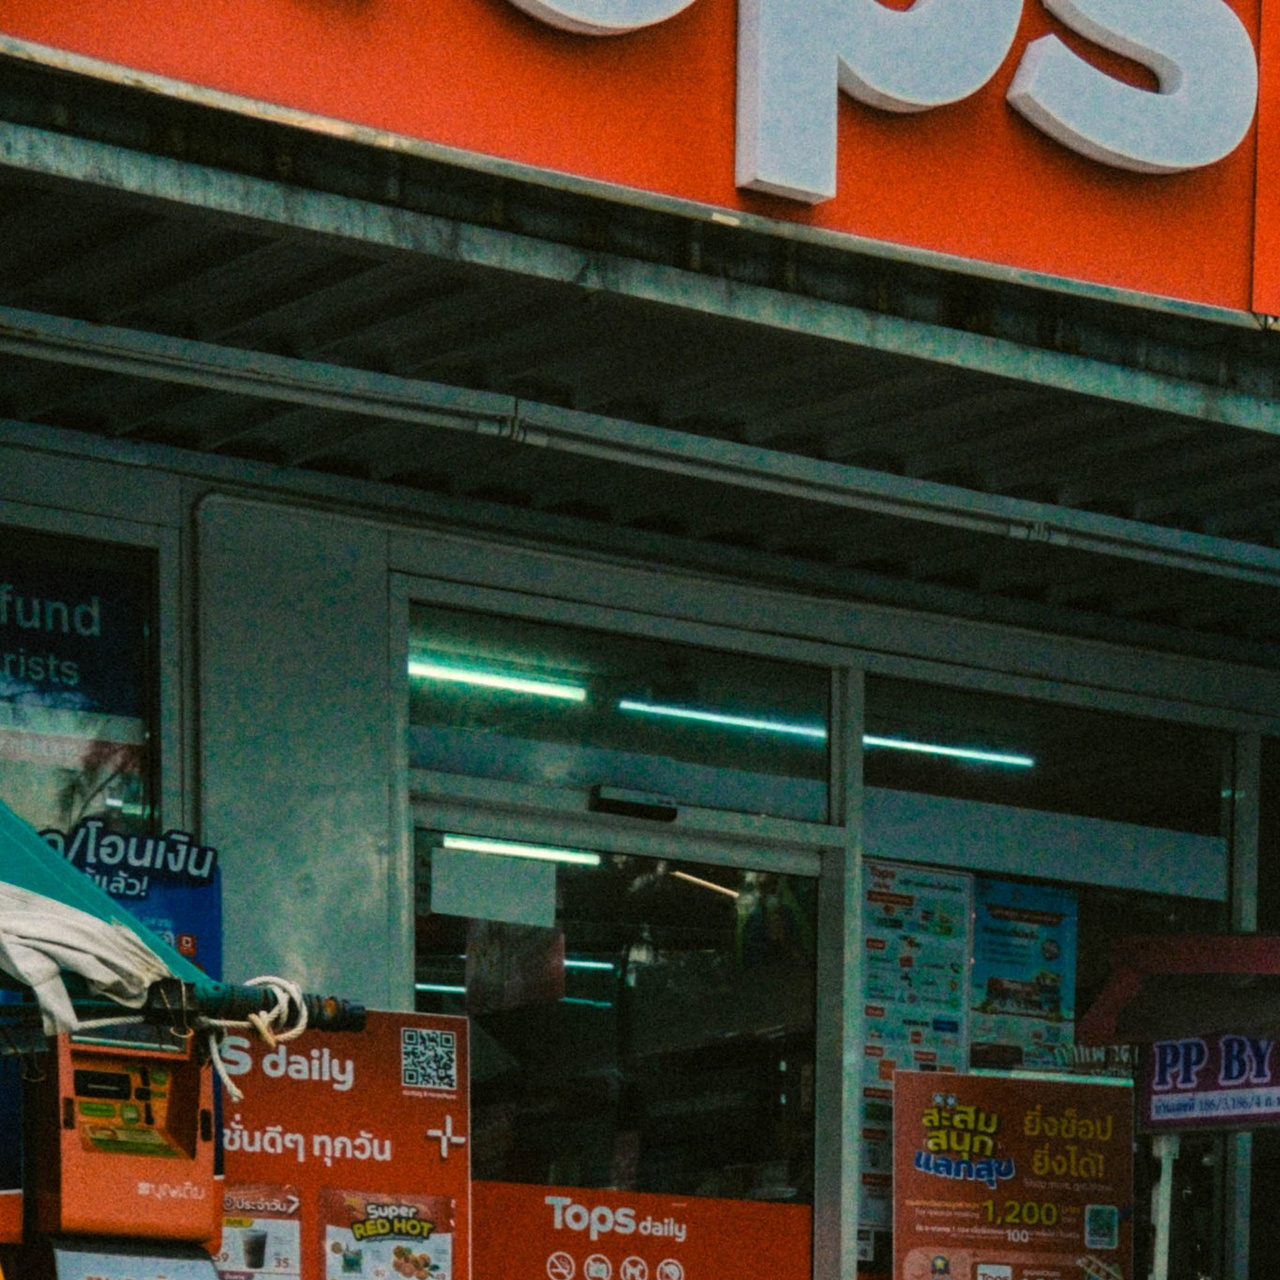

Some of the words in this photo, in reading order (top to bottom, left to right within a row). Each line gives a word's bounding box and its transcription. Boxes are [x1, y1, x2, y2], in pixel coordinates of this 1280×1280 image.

[505, 0, 1258, 204] ps
[262, 1044, 355, 1092] daily
[1154, 1038, 1208, 1089] PP
[1219, 1034, 1276, 1086] BY
[313, 1130, 392, 1167] ทุกวัน
[352, 1219, 390, 1238] RED
[393, 1220, 434, 1237] HOT
[366, 1204, 418, 1219] Super
[545, 1196, 637, 1241] Tops
[638, 1216, 687, 1242] daily
[981, 1199, 1058, 1226] 1,200
